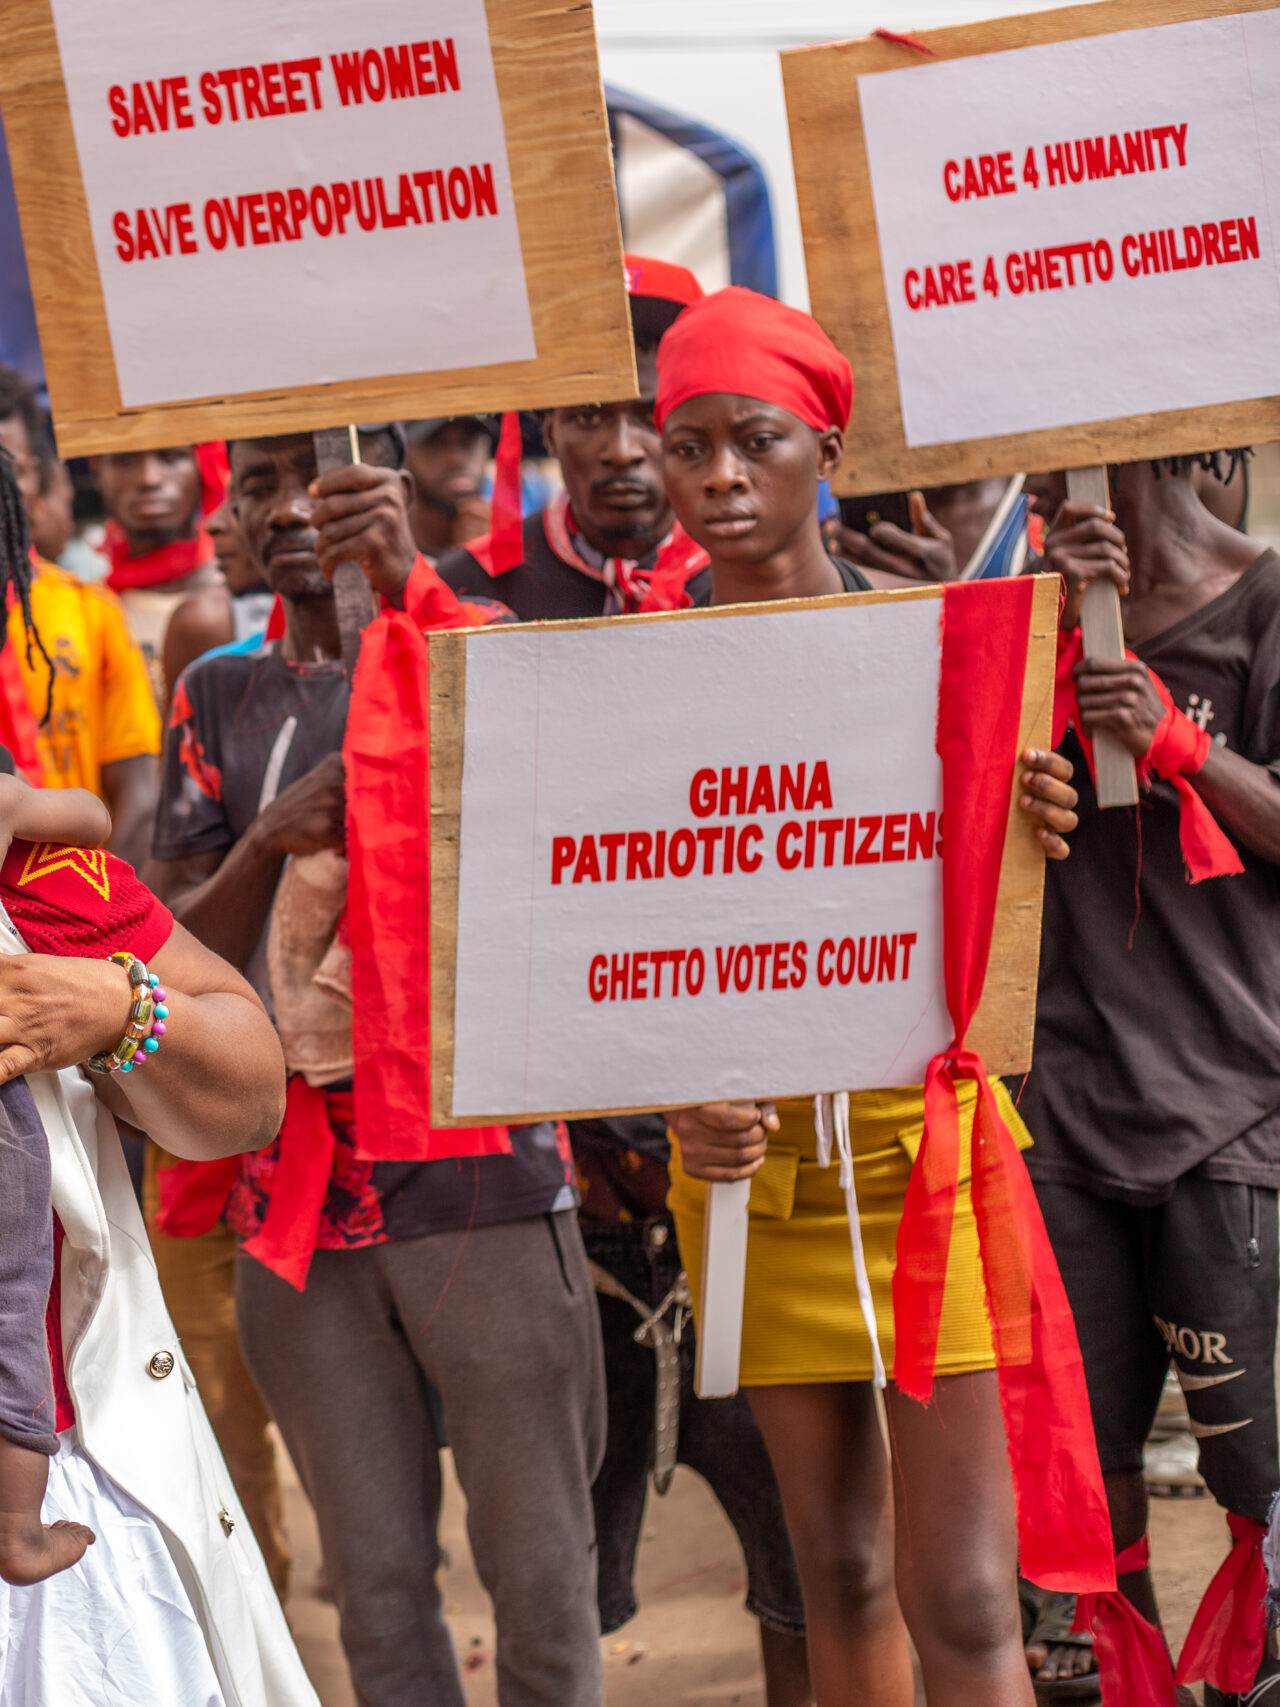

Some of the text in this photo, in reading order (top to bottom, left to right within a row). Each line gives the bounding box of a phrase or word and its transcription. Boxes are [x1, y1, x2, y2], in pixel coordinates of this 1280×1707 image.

[108, 38, 461, 138] SAVE STREET WOMEN
[943, 123, 1188, 203] CARE 4 HUMANITY
[112, 163, 498, 263] SAVE OVERPOPULATION
[904, 216, 1260, 311] CARE 4 GHETTO CHILDREN
[689, 760, 833, 818] GHANA
[551, 811, 943, 885] PATRIOTIC CITIZEN
[588, 932, 917, 1003] GHETTO VOTES COUNT
